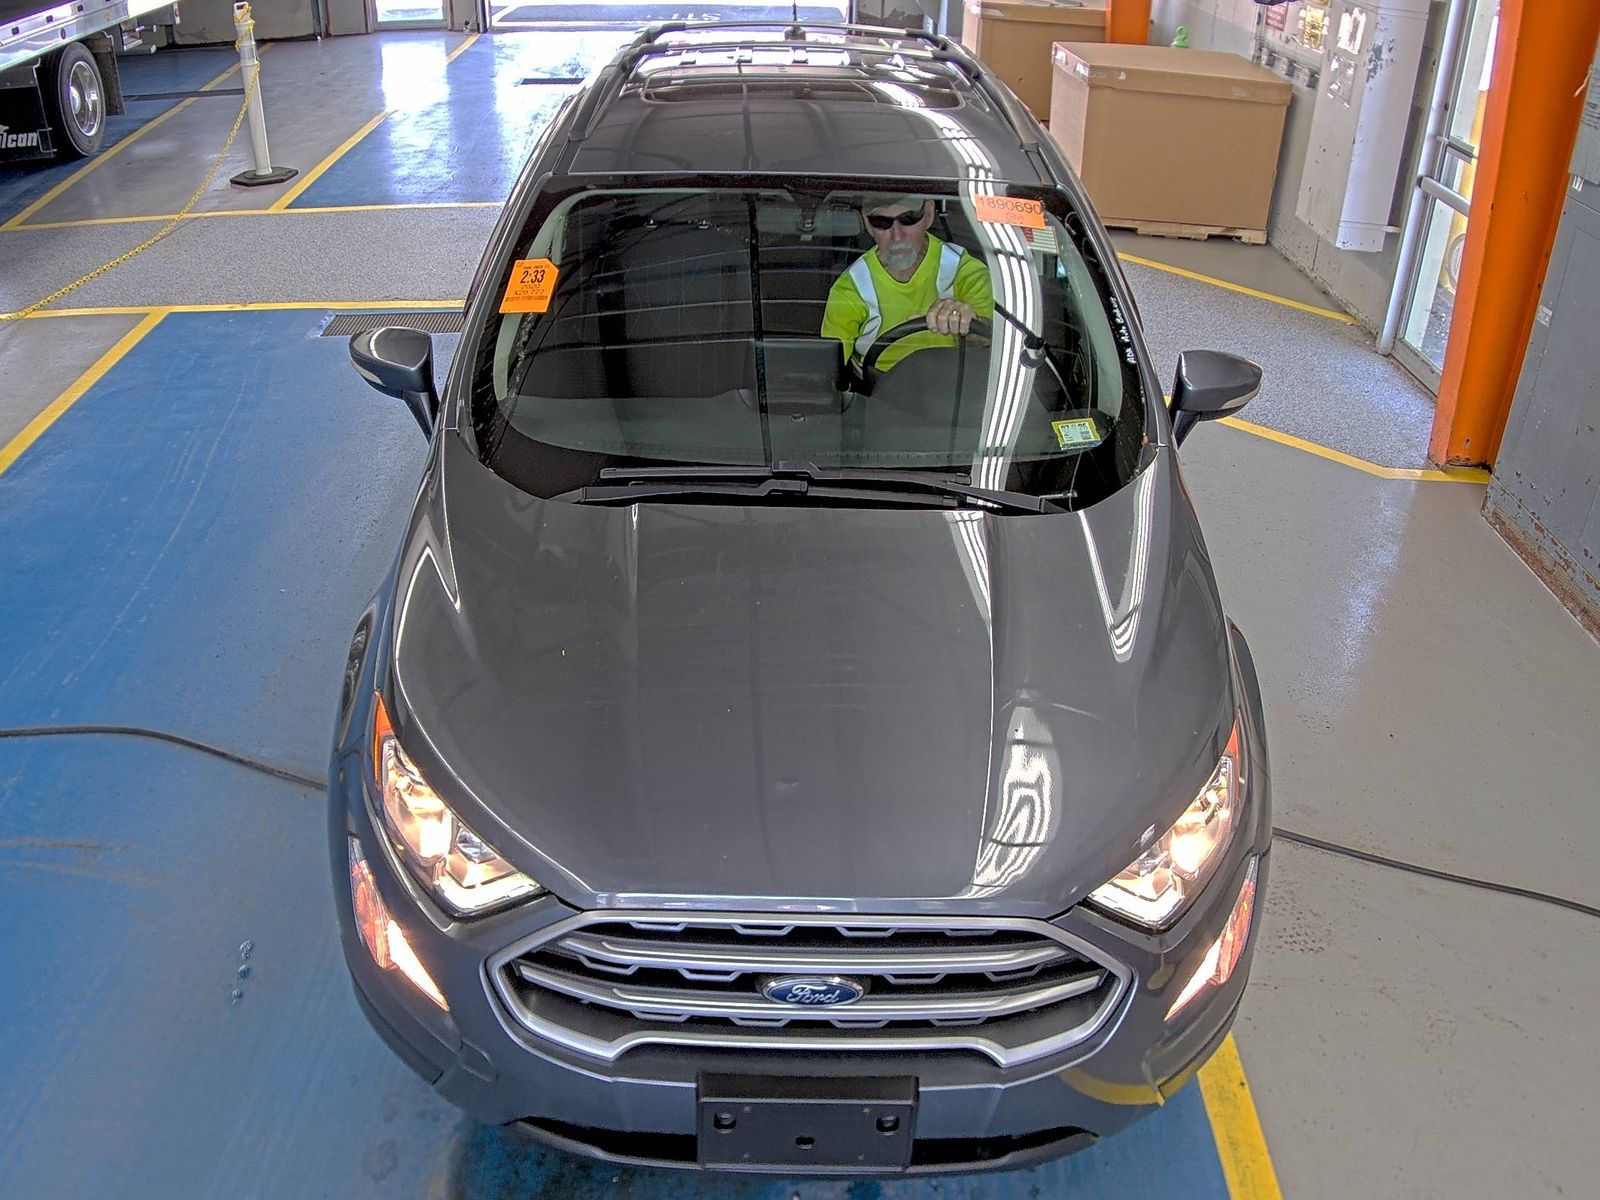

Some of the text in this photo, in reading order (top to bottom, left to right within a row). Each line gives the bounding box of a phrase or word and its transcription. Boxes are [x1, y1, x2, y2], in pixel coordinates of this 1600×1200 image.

[979, 196, 1042, 215] 1890690
[520, 269, 546, 284] 2:33
[785, 984, 840, 1004] Ford
